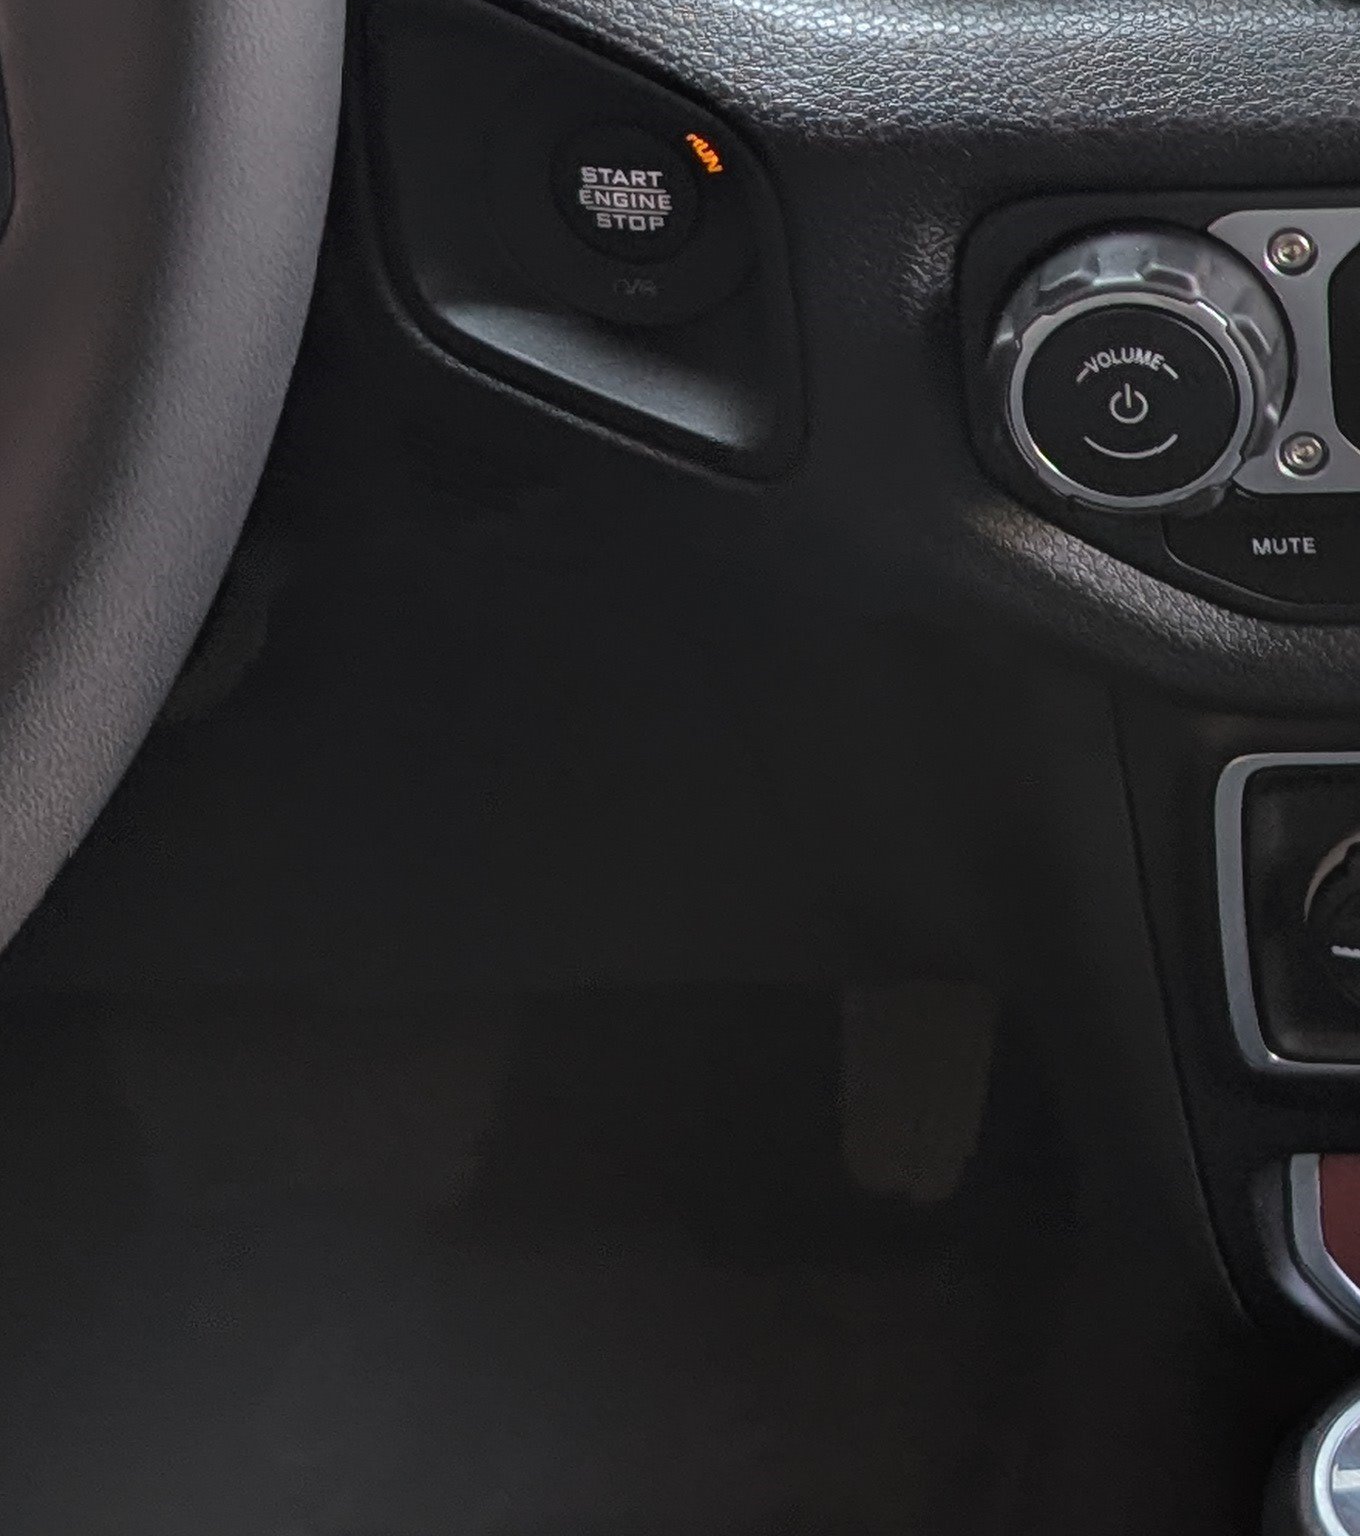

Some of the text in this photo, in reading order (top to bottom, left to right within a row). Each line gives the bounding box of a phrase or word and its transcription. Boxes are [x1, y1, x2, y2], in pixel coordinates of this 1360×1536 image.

[580, 166, 663, 188] START
[578, 188, 673, 210] ENGINE
[596, 214, 665, 232] STOP
[1083, 347, 1163, 374] VOLUME
[1251, 535, 1317, 556] MUTE
